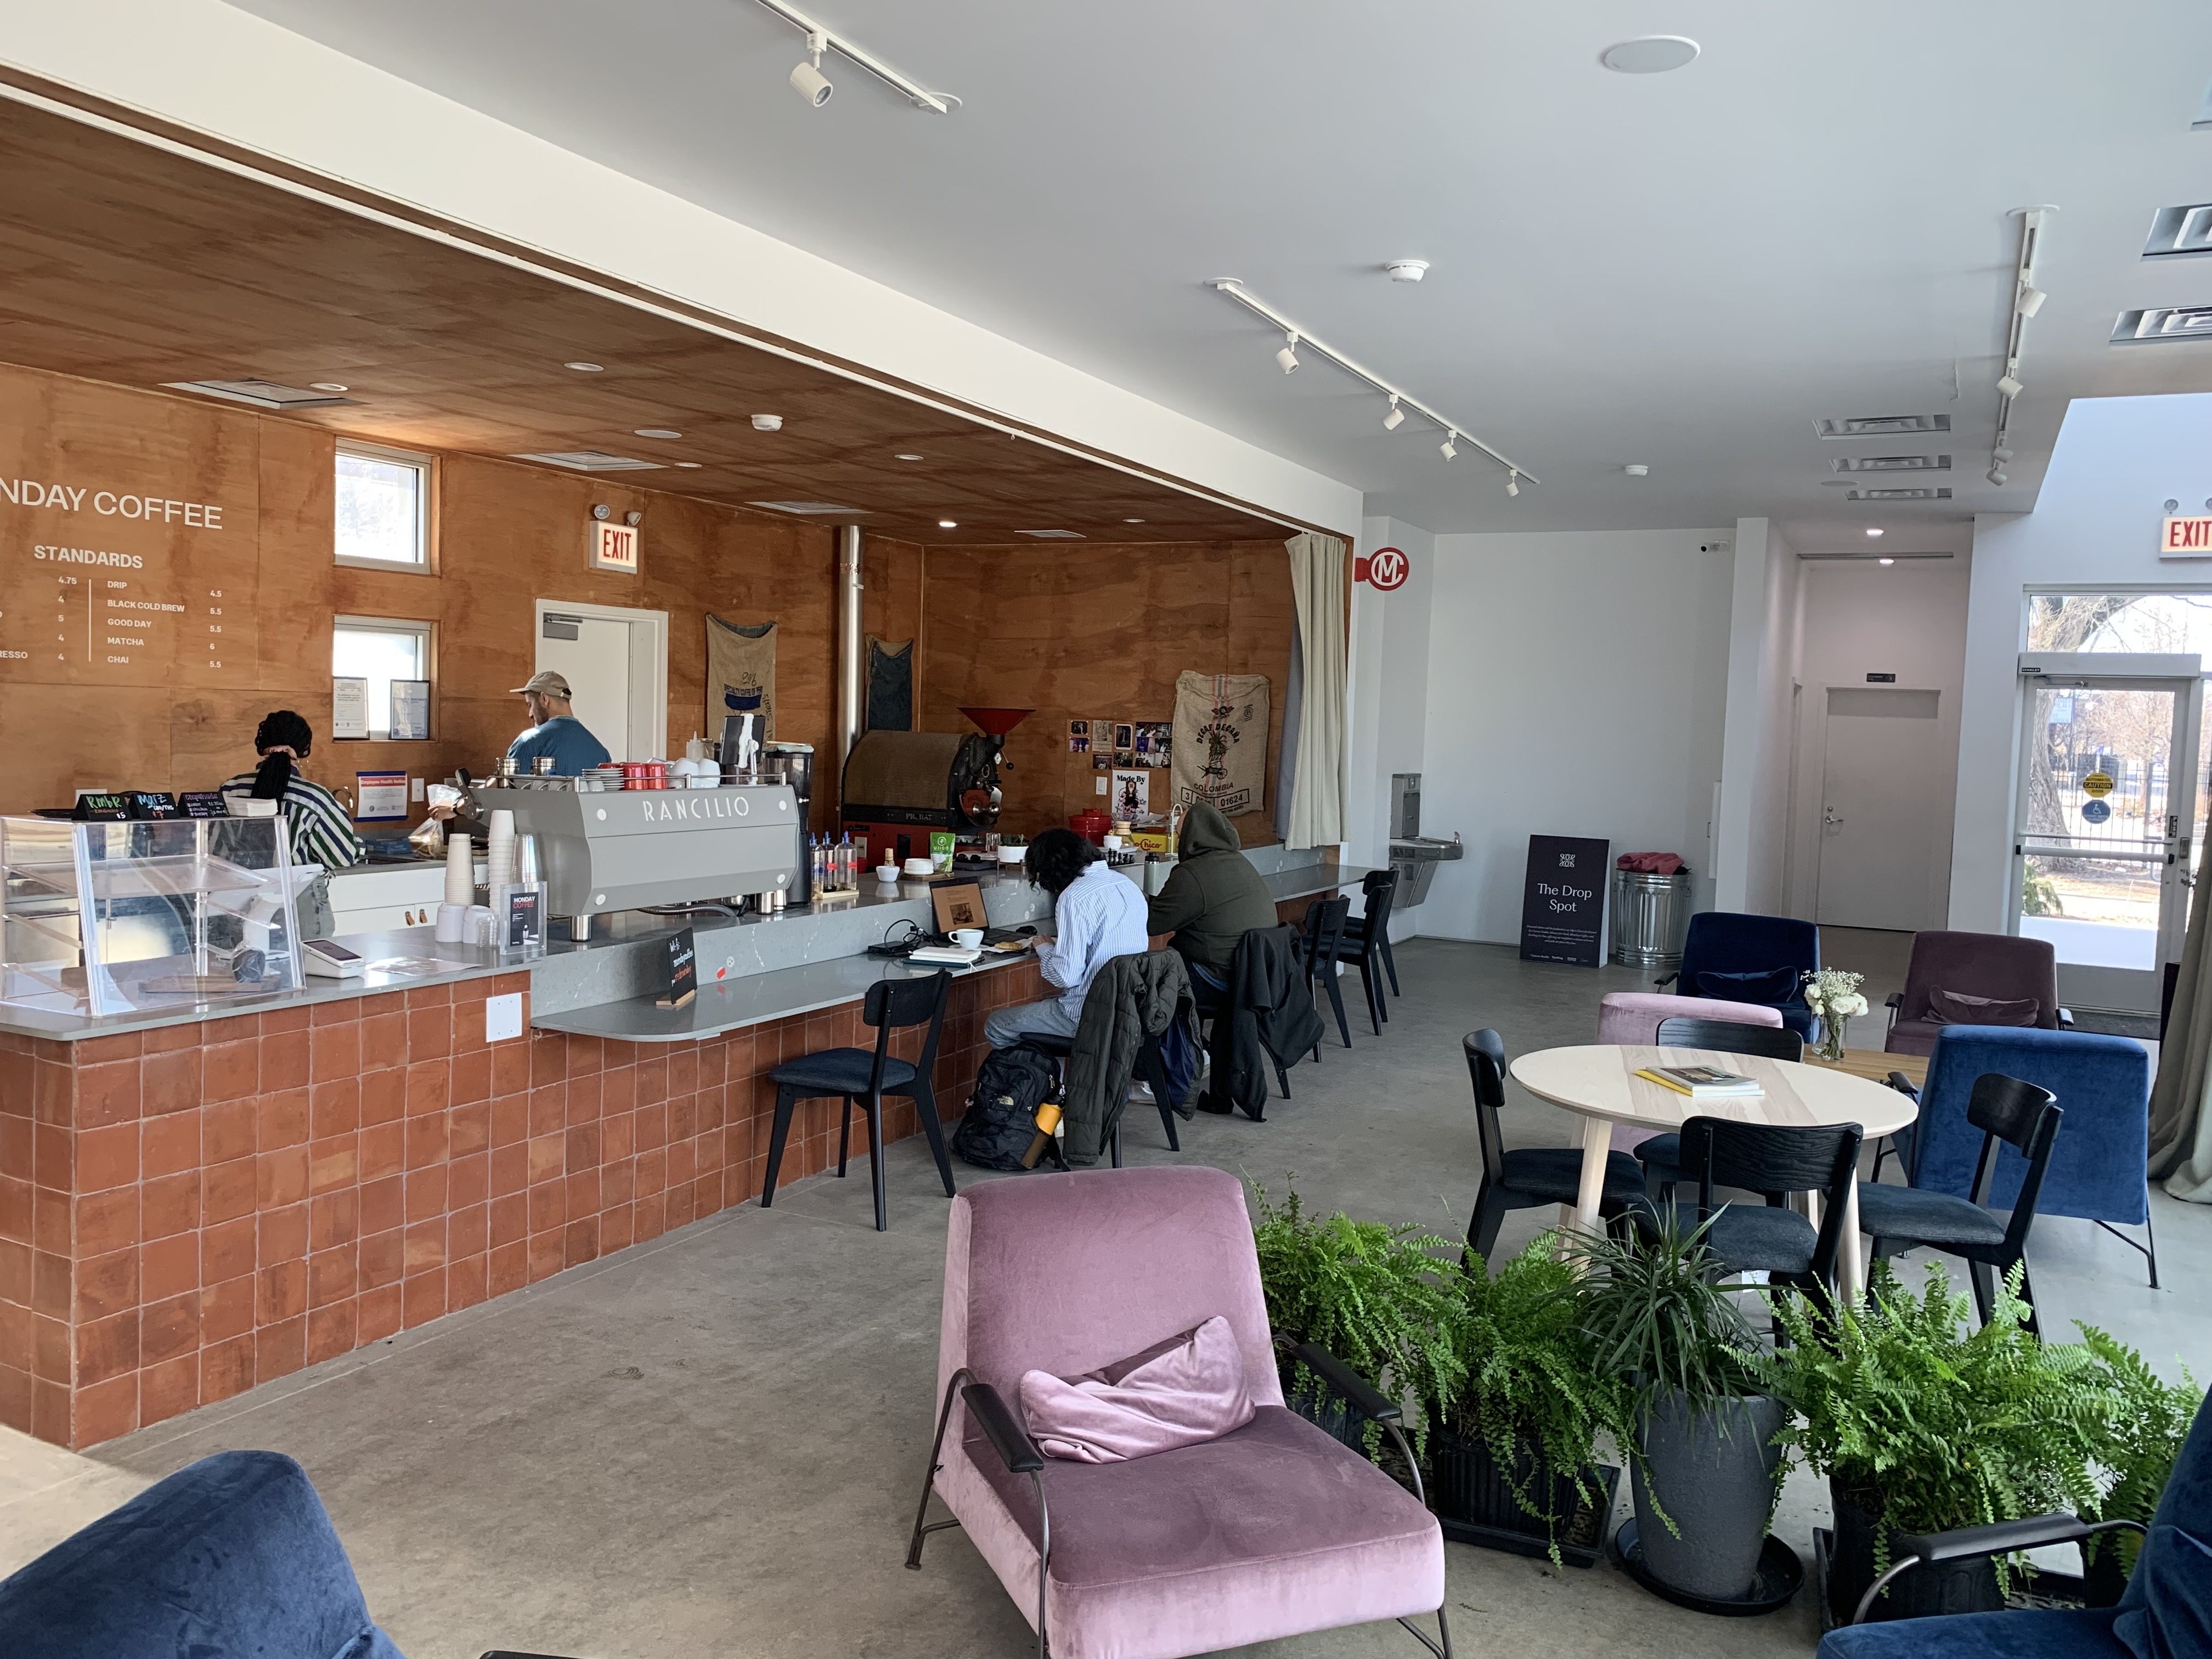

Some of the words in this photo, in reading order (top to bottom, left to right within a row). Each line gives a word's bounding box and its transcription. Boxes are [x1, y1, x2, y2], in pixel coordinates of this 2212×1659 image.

[0, 477, 87, 512] NDAY
[93, 491, 223, 530] COFFEE
[2170, 521, 2212, 547] EXIT
[603, 529, 631, 561] EXIT
[34, 545, 143, 569] STANDARDS
[58, 576, 77, 585] 4.75
[107, 580, 127, 589] DRIP
[107, 599, 137, 609] BLACK
[137, 601, 161, 611] COLD
[161, 603, 185, 613] BREW
[210, 607, 222, 616] 5.5
[107, 618, 134, 627] GOOD
[134, 619, 152, 628] DAY
[210, 625, 222, 633] 5.5
[107, 637, 144, 646] MATCHA
[58, 653, 65, 661] 4
[107, 656, 129, 664] CHAI
[1196, 724, 1213, 744] DECAF
[1136, 775, 1146, 785] By
[1194, 782, 1234, 792] COLOMBIA
[1220, 794, 1243, 806] 01624
[642, 796, 749, 821] RANCILIO
[1141, 838, 1162, 851] Chico
[1537, 883, 1559, 895] The
[1562, 885, 1592, 901] Drop
[514, 895, 535, 904] MONDAY
[1549, 899, 1577, 913] Spot
